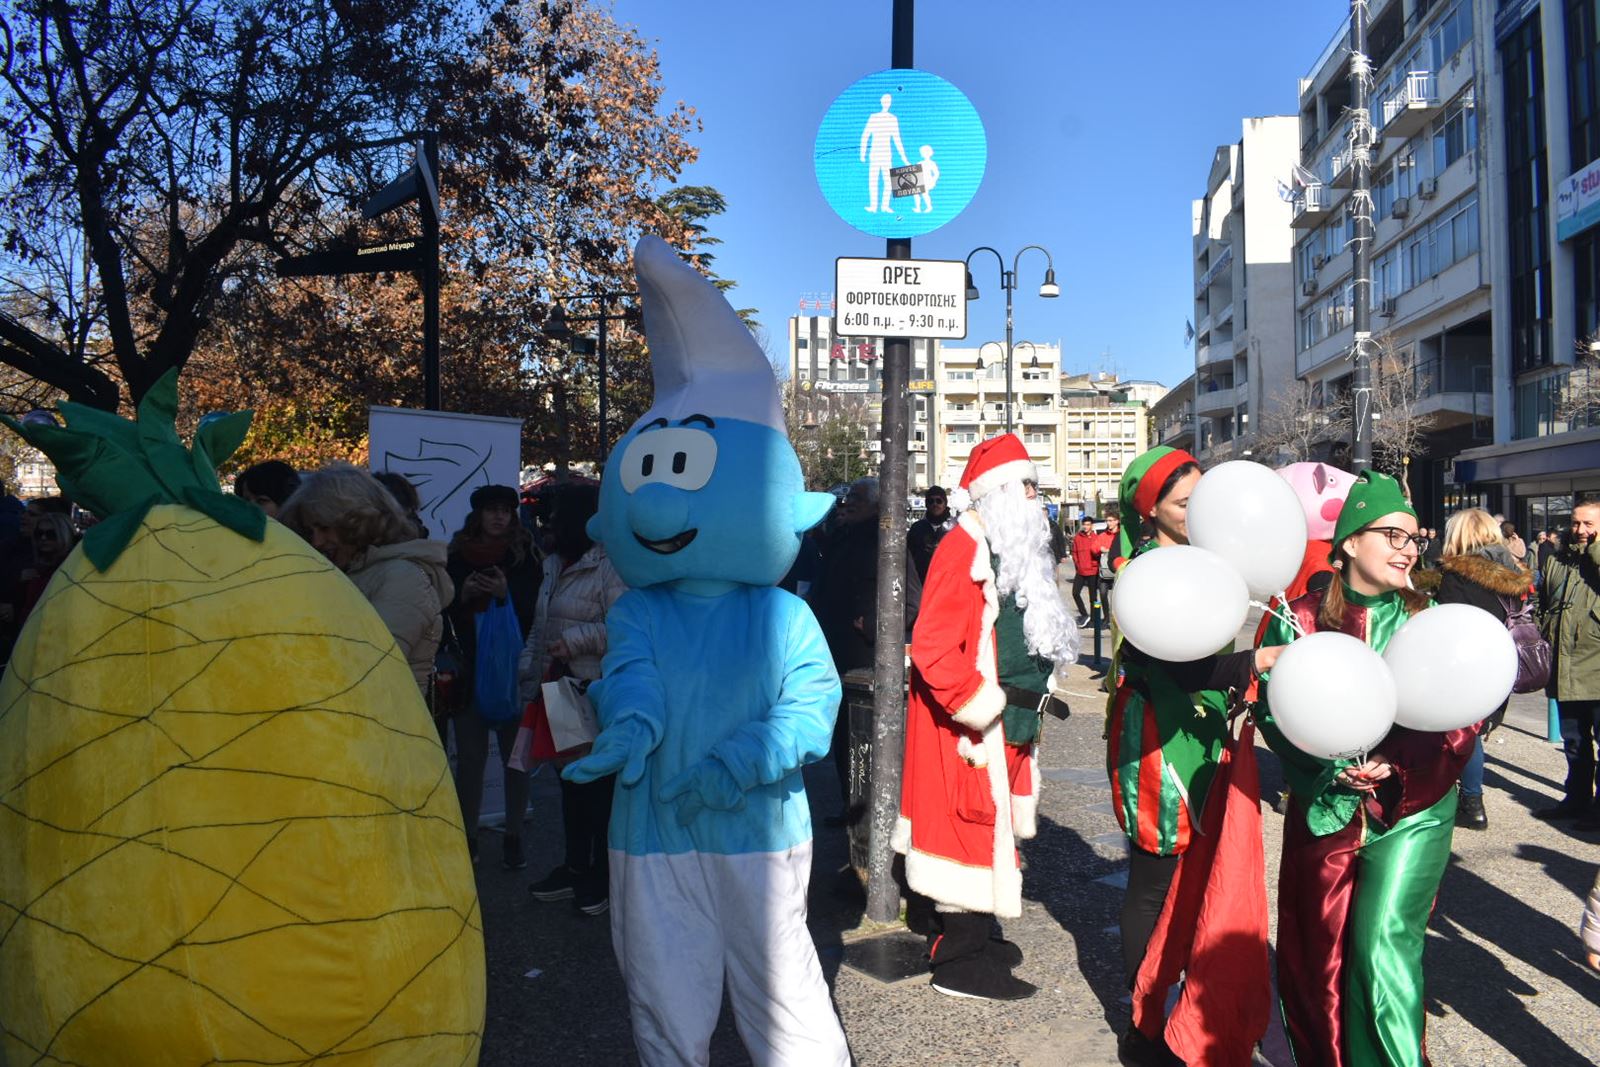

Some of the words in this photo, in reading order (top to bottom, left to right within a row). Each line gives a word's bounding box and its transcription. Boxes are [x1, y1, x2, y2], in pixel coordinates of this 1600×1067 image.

[357, 244, 388, 256] Δικαστικό
[388, 242, 415, 251] Μέγαρο
[882, 266, 921, 285] ΩΡΕΣ
[846, 291, 957, 308] ΦΟΡΤΟΕΚΦΟΡΤΩΣΗΣ
[844, 312, 869, 326] 6:00
[909, 314, 934, 328] 9:30
[814, 380, 870, 390] Fitness
